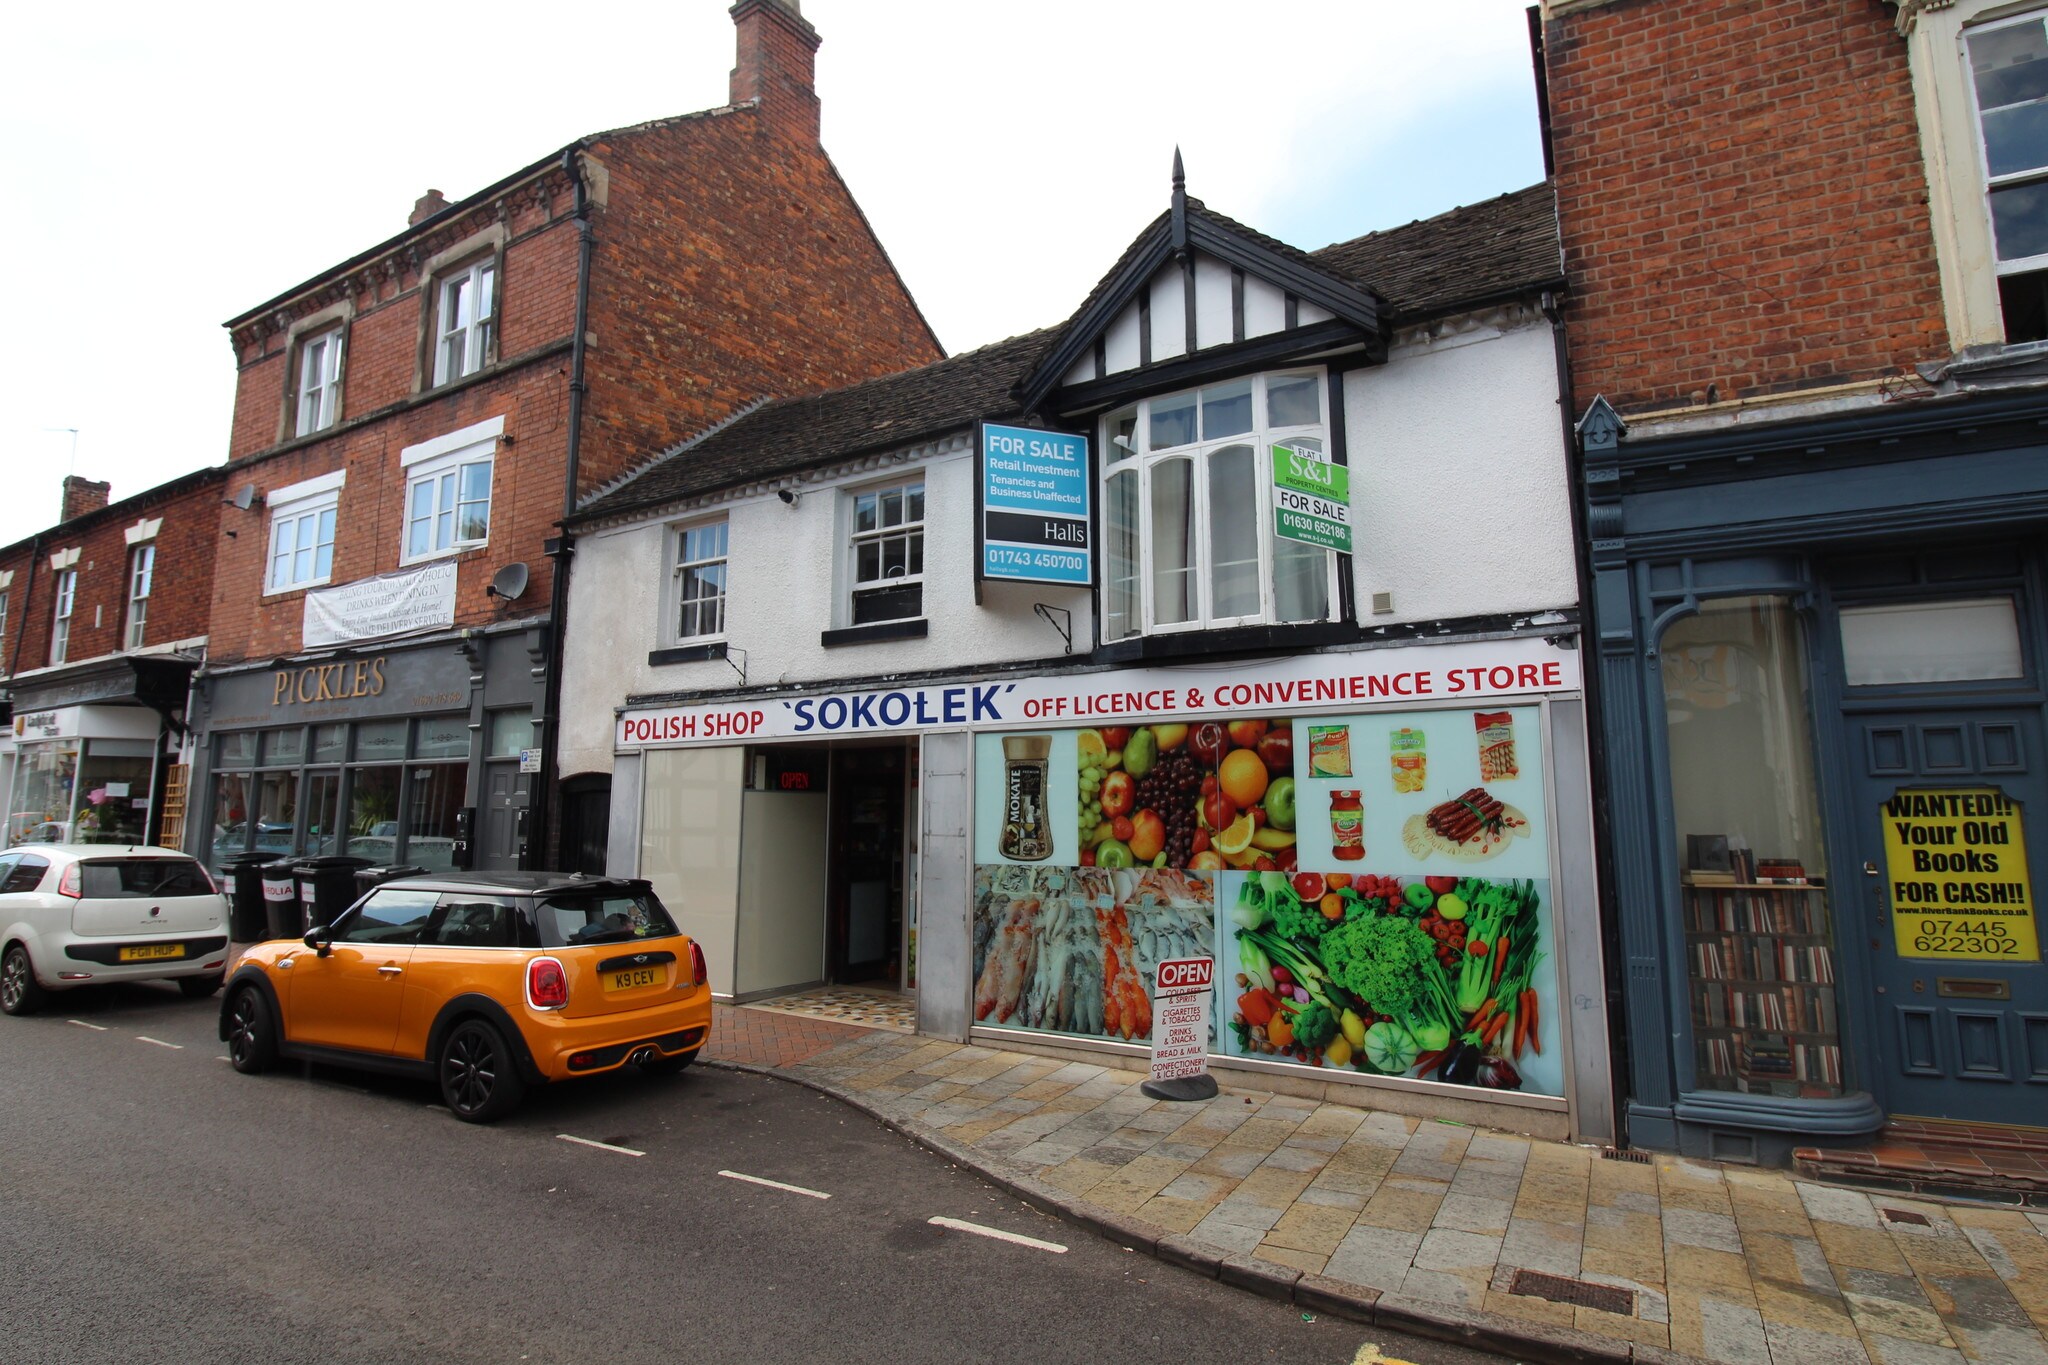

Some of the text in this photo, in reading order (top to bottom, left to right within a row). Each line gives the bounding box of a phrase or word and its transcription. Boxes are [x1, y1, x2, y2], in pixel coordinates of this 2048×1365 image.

[990, 436, 1074, 461] FOR SALE
[1298, 448, 1316, 460] FLAT
[990, 458, 1080, 477] Retail Investment
[1290, 454, 1332, 485] S&J
[990, 474, 1054, 489] Tenancies and
[1286, 477, 1315, 490] PROPERTY
[1316, 486, 1338, 497] CENTRES
[990, 486, 1081, 504] Business Unaffected
[1281, 492, 1345, 521] FOR SALE
[1045, 522, 1084, 542] Halls
[1284, 513, 1345, 539] 01630 652186
[989, 550, 1082, 570] 01743 450700
[339, 585, 362, 600] BRING
[364, 580, 384, 596] YOUR
[346, 597, 376, 612] DRINKS
[374, 592, 398, 607] WHEN
[429, 584, 439, 596] IN
[412, 605, 420, 614] At
[420, 600, 442, 612] Home!
[334, 628, 353, 640] FREE
[353, 624, 376, 638] HOME
[376, 617, 414, 634] DELIVERY
[414, 612, 448, 628] SERVICE
[272, 657, 388, 706] PICKLES
[624, 715, 696, 741] POLISH
[704, 710, 764, 737] SHOP
[1024, 697, 1067, 718] OFF
[1074, 690, 1176, 715] LICENCE
[1186, 688, 1205, 708] &
[1214, 672, 1433, 706] CONVENIENCE
[1447, 662, 1562, 693] STORE
[781, 771, 808, 789] OPEN
[1010, 770, 1020, 822] MOKATE
[1886, 794, 2012, 817] WANTED!!
[1895, 821, 2008, 845] Your Old
[1912, 850, 1999, 872] Books
[1895, 882, 2024, 904] FOR CASH!!
[1896, 907, 2028, 916] www.RiverBankBooks.co.uk
[1921, 920, 2007, 937] 07445
[154, 946, 175, 956] HUP
[1915, 936, 2019, 954] 622302
[616, 970, 654, 988] K9 CEV
[1162, 963, 1210, 984] OPEN
[1176, 995, 1196, 1004] SPIRITS
[1162, 1014, 1200, 1025] & TOBACCO
[1163, 1007, 1200, 1017] CIGARETTES
[1170, 1028, 1192, 1037] DRINKS
[1171, 1034, 1197, 1044] SNACKS
[1157, 1049, 1178, 1058] BREAD
[1187, 1046, 1201, 1055] MILK
[1152, 1058, 1206, 1071] CONFECTIONERY
[1164, 1070, 1174, 1078] ICE
[1177, 1067, 1200, 1076] CREAM
